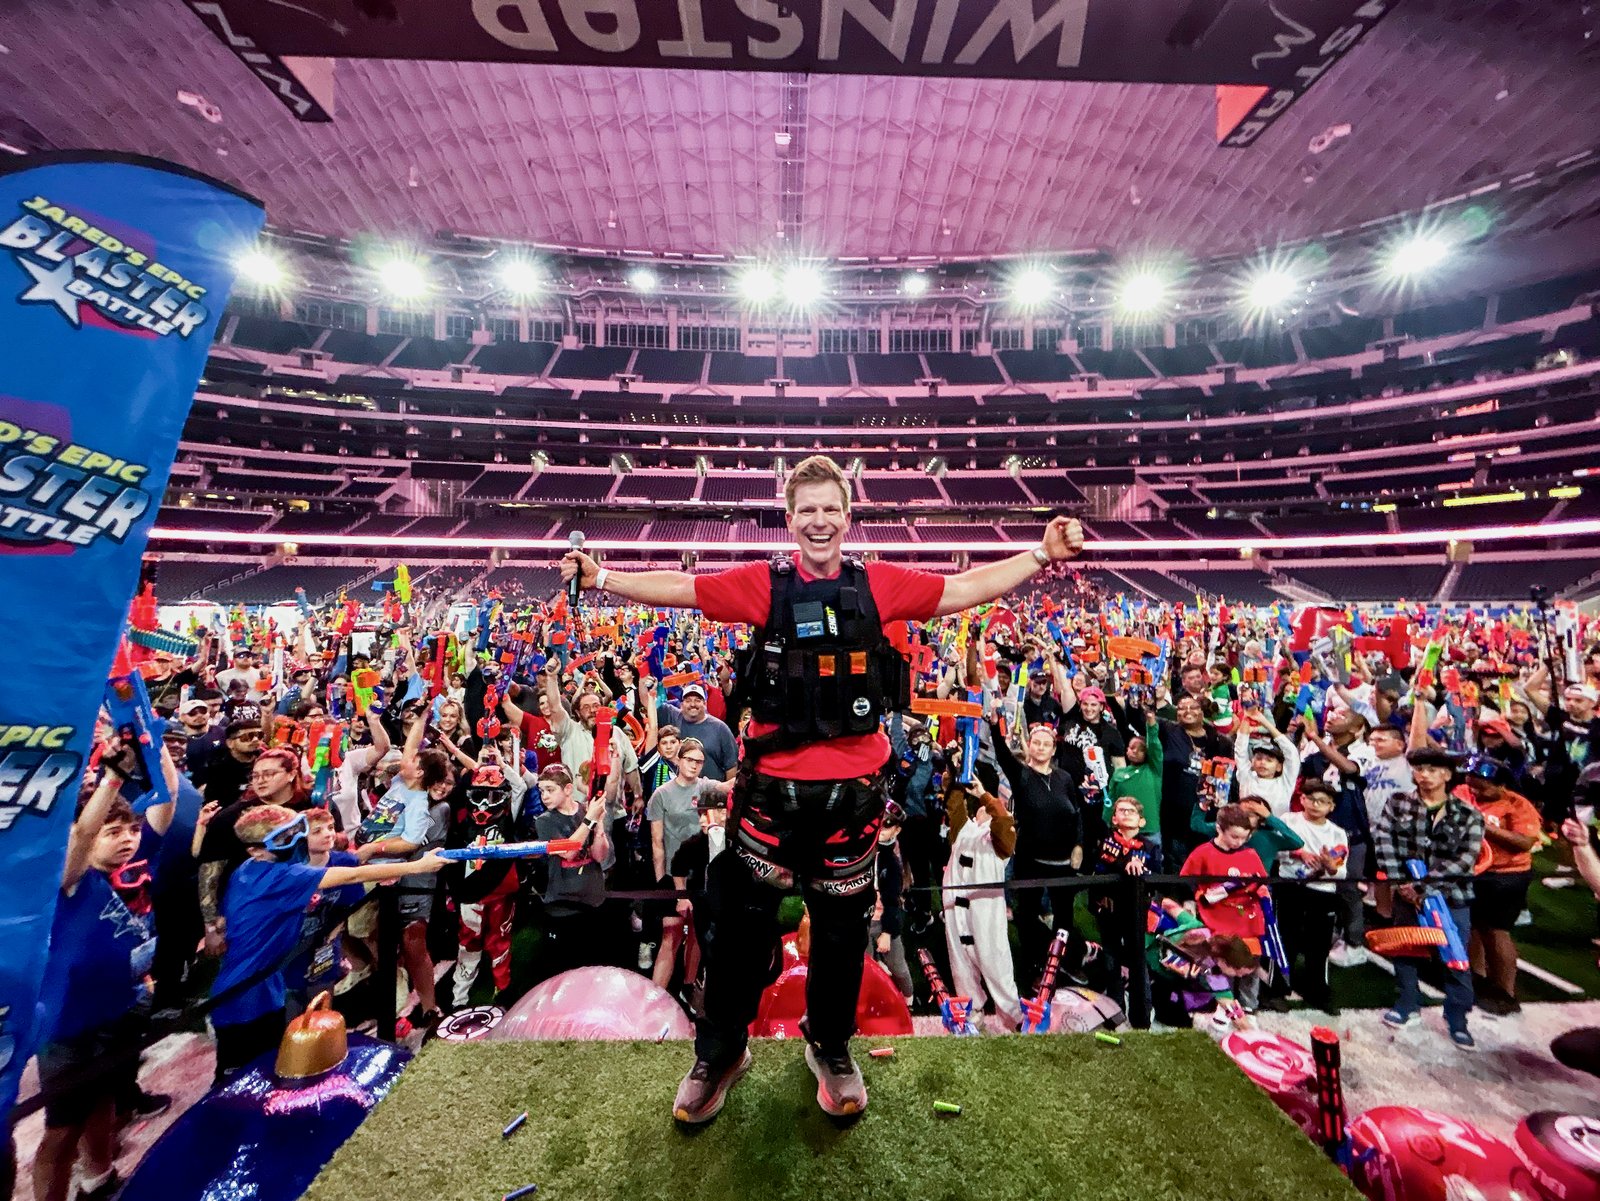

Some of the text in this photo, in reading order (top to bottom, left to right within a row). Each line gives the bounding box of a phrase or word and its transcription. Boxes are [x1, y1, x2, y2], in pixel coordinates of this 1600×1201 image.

[0, 214, 208, 337] BLASTER
[22, 196, 207, 300] JARED'S EPIC
[66, 279, 176, 336] BATTLE
[58, 444, 148, 483] EPIC
[0, 725, 74, 748] PIC
